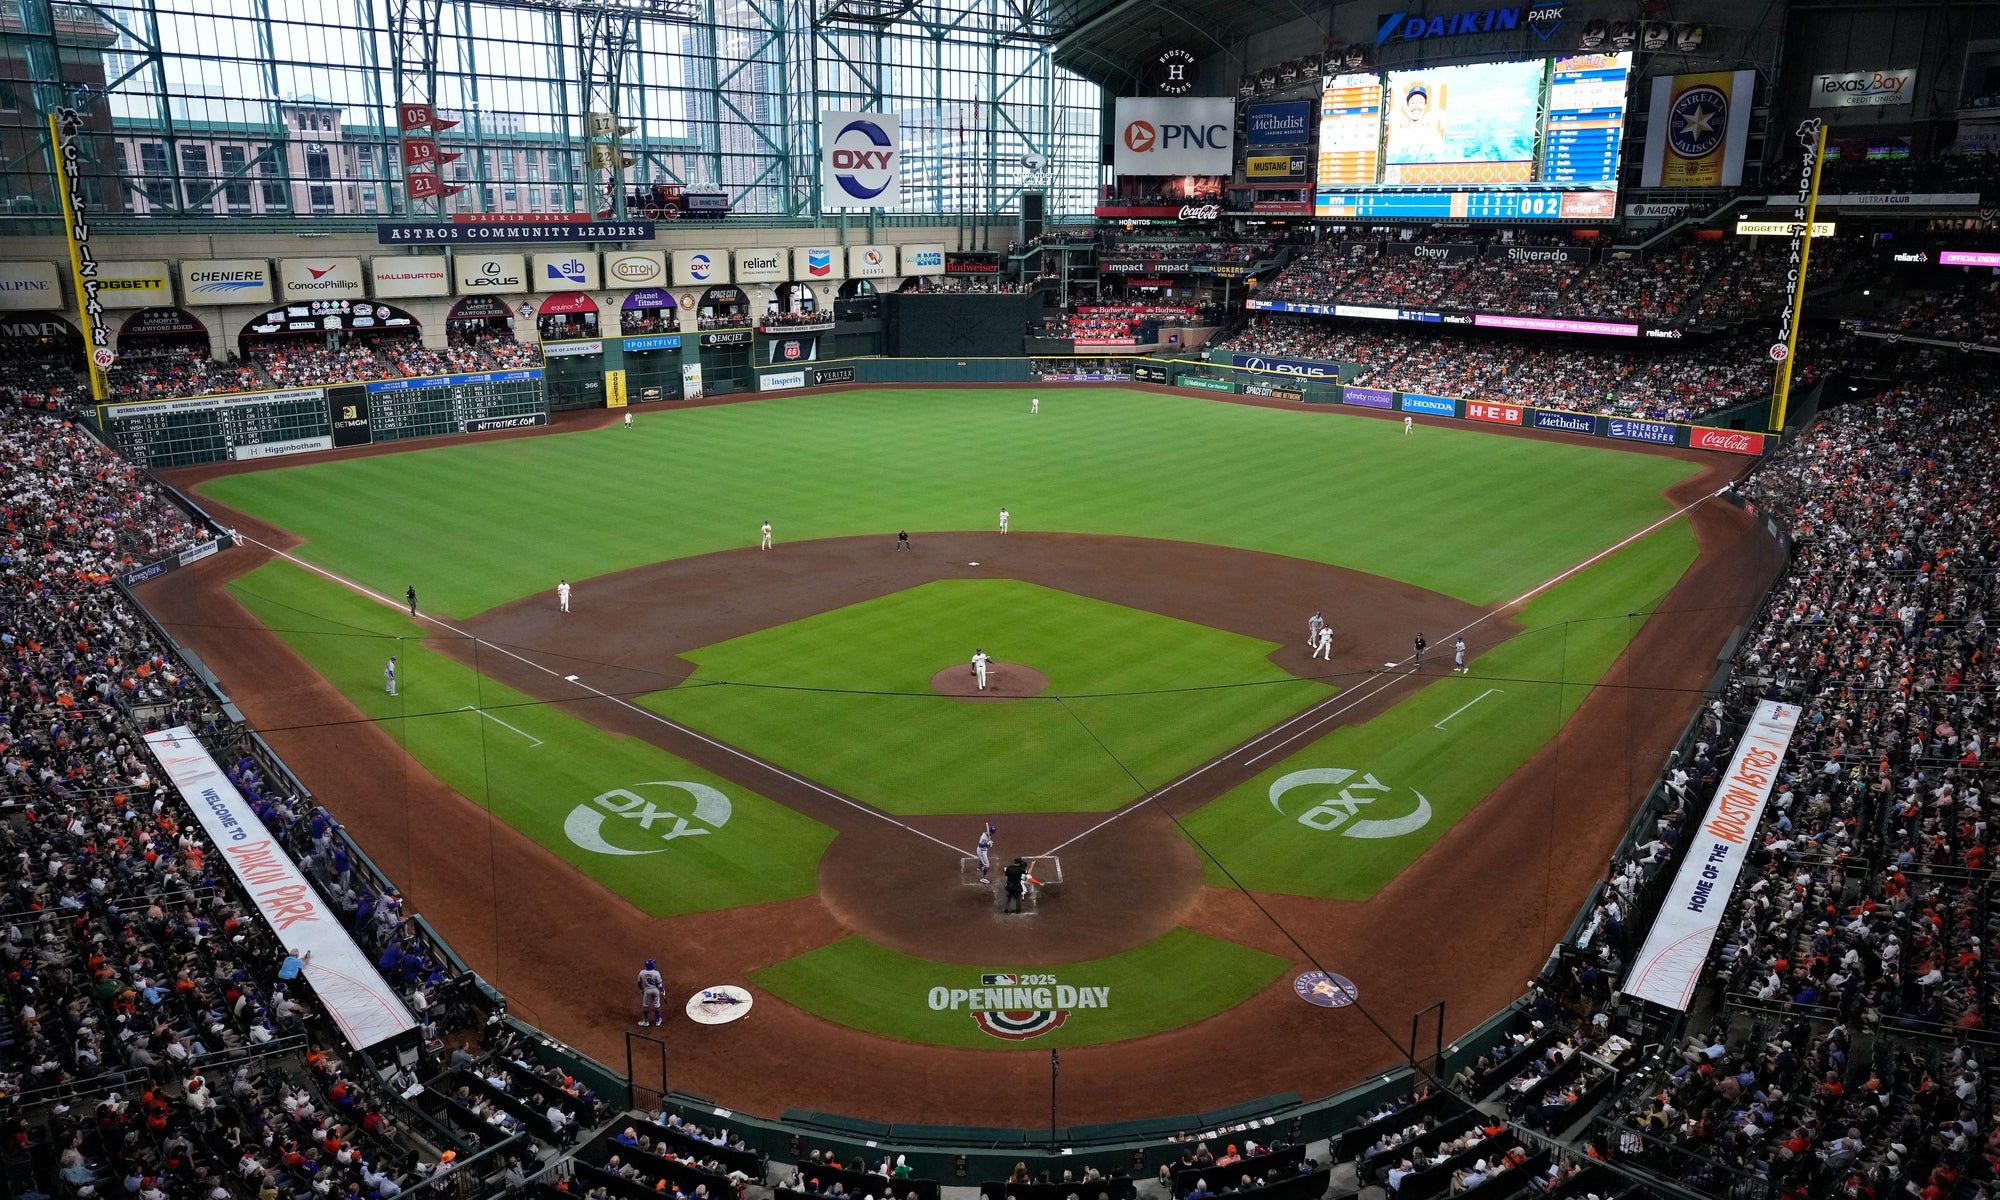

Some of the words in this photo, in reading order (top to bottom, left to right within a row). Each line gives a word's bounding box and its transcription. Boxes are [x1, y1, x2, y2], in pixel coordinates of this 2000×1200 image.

[1404, 8, 1521, 38] DAIKIN
[1528, 8, 1563, 22] PARK
[1160, 50, 1194, 63] HOUSTON
[1564, 56, 1608, 71] ASTROS
[1169, 65, 1184, 80] H
[1160, 82, 1192, 94] ASTROS
[1820, 77, 1865, 93] Texas
[1871, 72, 1909, 94] Bay
[1676, 92, 1724, 115] ESTRELLA
[1874, 95, 1902, 103] UNION
[408, 109, 427, 123] 05
[1252, 115, 1304, 130] Methodist
[594, 118, 611, 131] 17
[1159, 124, 1227, 149] PNC
[1675, 137, 1717, 152] JALISCO
[412, 145, 430, 158] 19
[597, 151, 612, 163] 22
[832, 149, 894, 170] OXY
[1253, 161, 1287, 171] MUSTANG
[1291, 160, 1304, 171] CAT
[415, 178, 432, 190] 21
[1798, 153, 1815, 203] ROOT
[64, 145, 89, 242] CHIKIN
[1889, 195, 1910, 203] CLUB
[1178, 204, 1221, 221] Coca-Cola
[1565, 203, 1601, 213] reliant
[1794, 209, 1806, 221] 4
[391, 229, 459, 239] ASTROS
[467, 227, 571, 238] COMMUNITY
[578, 226, 645, 236] LEADERS
[1740, 225, 1785, 233] DOGGETT
[1789, 225, 1805, 264] THA
[81, 244, 98, 277] IZ
[1414, 246, 1449, 259] Chevy
[1508, 248, 1568, 262] Silverado
[1894, 253, 1919, 262] reliant
[1947, 254, 1977, 263] OFFICIAL
[562, 259, 585, 274] slb
[617, 262, 653, 277] COTTON
[691, 263, 710, 271] OXY
[743, 257, 777, 269] reliant
[946, 262, 998, 272] Budweiser
[1109, 263, 1144, 273] impact
[1154, 263, 1189, 273] impact
[190, 271, 263, 282] CHENIERE
[377, 272, 444, 280] HALLIBURTON
[465, 277, 519, 287] LEXUS
[1127, 277, 1174, 287] Budweiser
[287, 280, 359, 291] ConocoPhillips
[635, 292, 658, 301] planet
[710, 290, 724, 299] SPACE
[724, 289, 738, 299] CITY
[551, 303, 574, 312] equinor
[638, 298, 663, 307] fitness
[1777, 268, 1798, 341] CHIKIN
[85, 280, 108, 346] FAIR
[457, 309, 488, 317] CRAWFORD
[1323, 305, 1330, 314] K
[143, 317, 180, 325] LANDRY'S
[1443, 316, 1465, 324] reliant
[1477, 317, 1502, 325] OFFICIAL
[1525, 320, 1555, 329] PROVIDER
[1578, 324, 1611, 332] HOUSTON
[1611, 326, 1637, 334] ASTROS
[1646, 328, 1673, 338] reliant
[1, 323, 67, 337] MAVEN
[627, 339, 678, 348] 1POINTFIVE
[787, 348, 798, 356] 66
[823, 370, 852, 378] VERITEX
[1267, 363, 1324, 376] LEXUS
[771, 376, 802, 387] Insperity
[1246, 385, 1259, 395] SPACE
[1259, 387, 1273, 397] CITY
[1345, 390, 1367, 402] xfinity
[1367, 392, 1390, 403] mobile
[1413, 400, 1454, 411] HONDA
[335, 419, 368, 428] BETMGM
[477, 416, 535, 431] NITTOTIRE.COM
[1538, 414, 1590, 431] Methodist
[1626, 421, 1666, 432] ENERGY
[222, 411, 235, 459] NATIONAL
[1626, 428, 1674, 443] TRANSFER
[1701, 431, 1751, 450] Coca-Cola
[265, 442, 321, 454] Higginbotham
[1730, 745, 1778, 791] ASTROS
[1297, 772, 1393, 831] OXY
[201, 787, 239, 828] WELCOME
[229, 826, 247, 841] TO
[593, 788, 712, 841] OXY
[1703, 782, 1759, 845] HOUSTON
[1709, 843, 1729, 866] THE
[1701, 863, 1720, 881] OF
[226, 839, 291, 886] DAIKIN
[268, 883, 320, 931] PARK
[1687, 880, 1714, 913] HOME
[1021, 974, 1057, 986] 2025
[1297, 972, 1323, 994] HOUSTON
[928, 986, 1052, 1011] OPENING
[1056, 985, 1110, 1009] DAY
